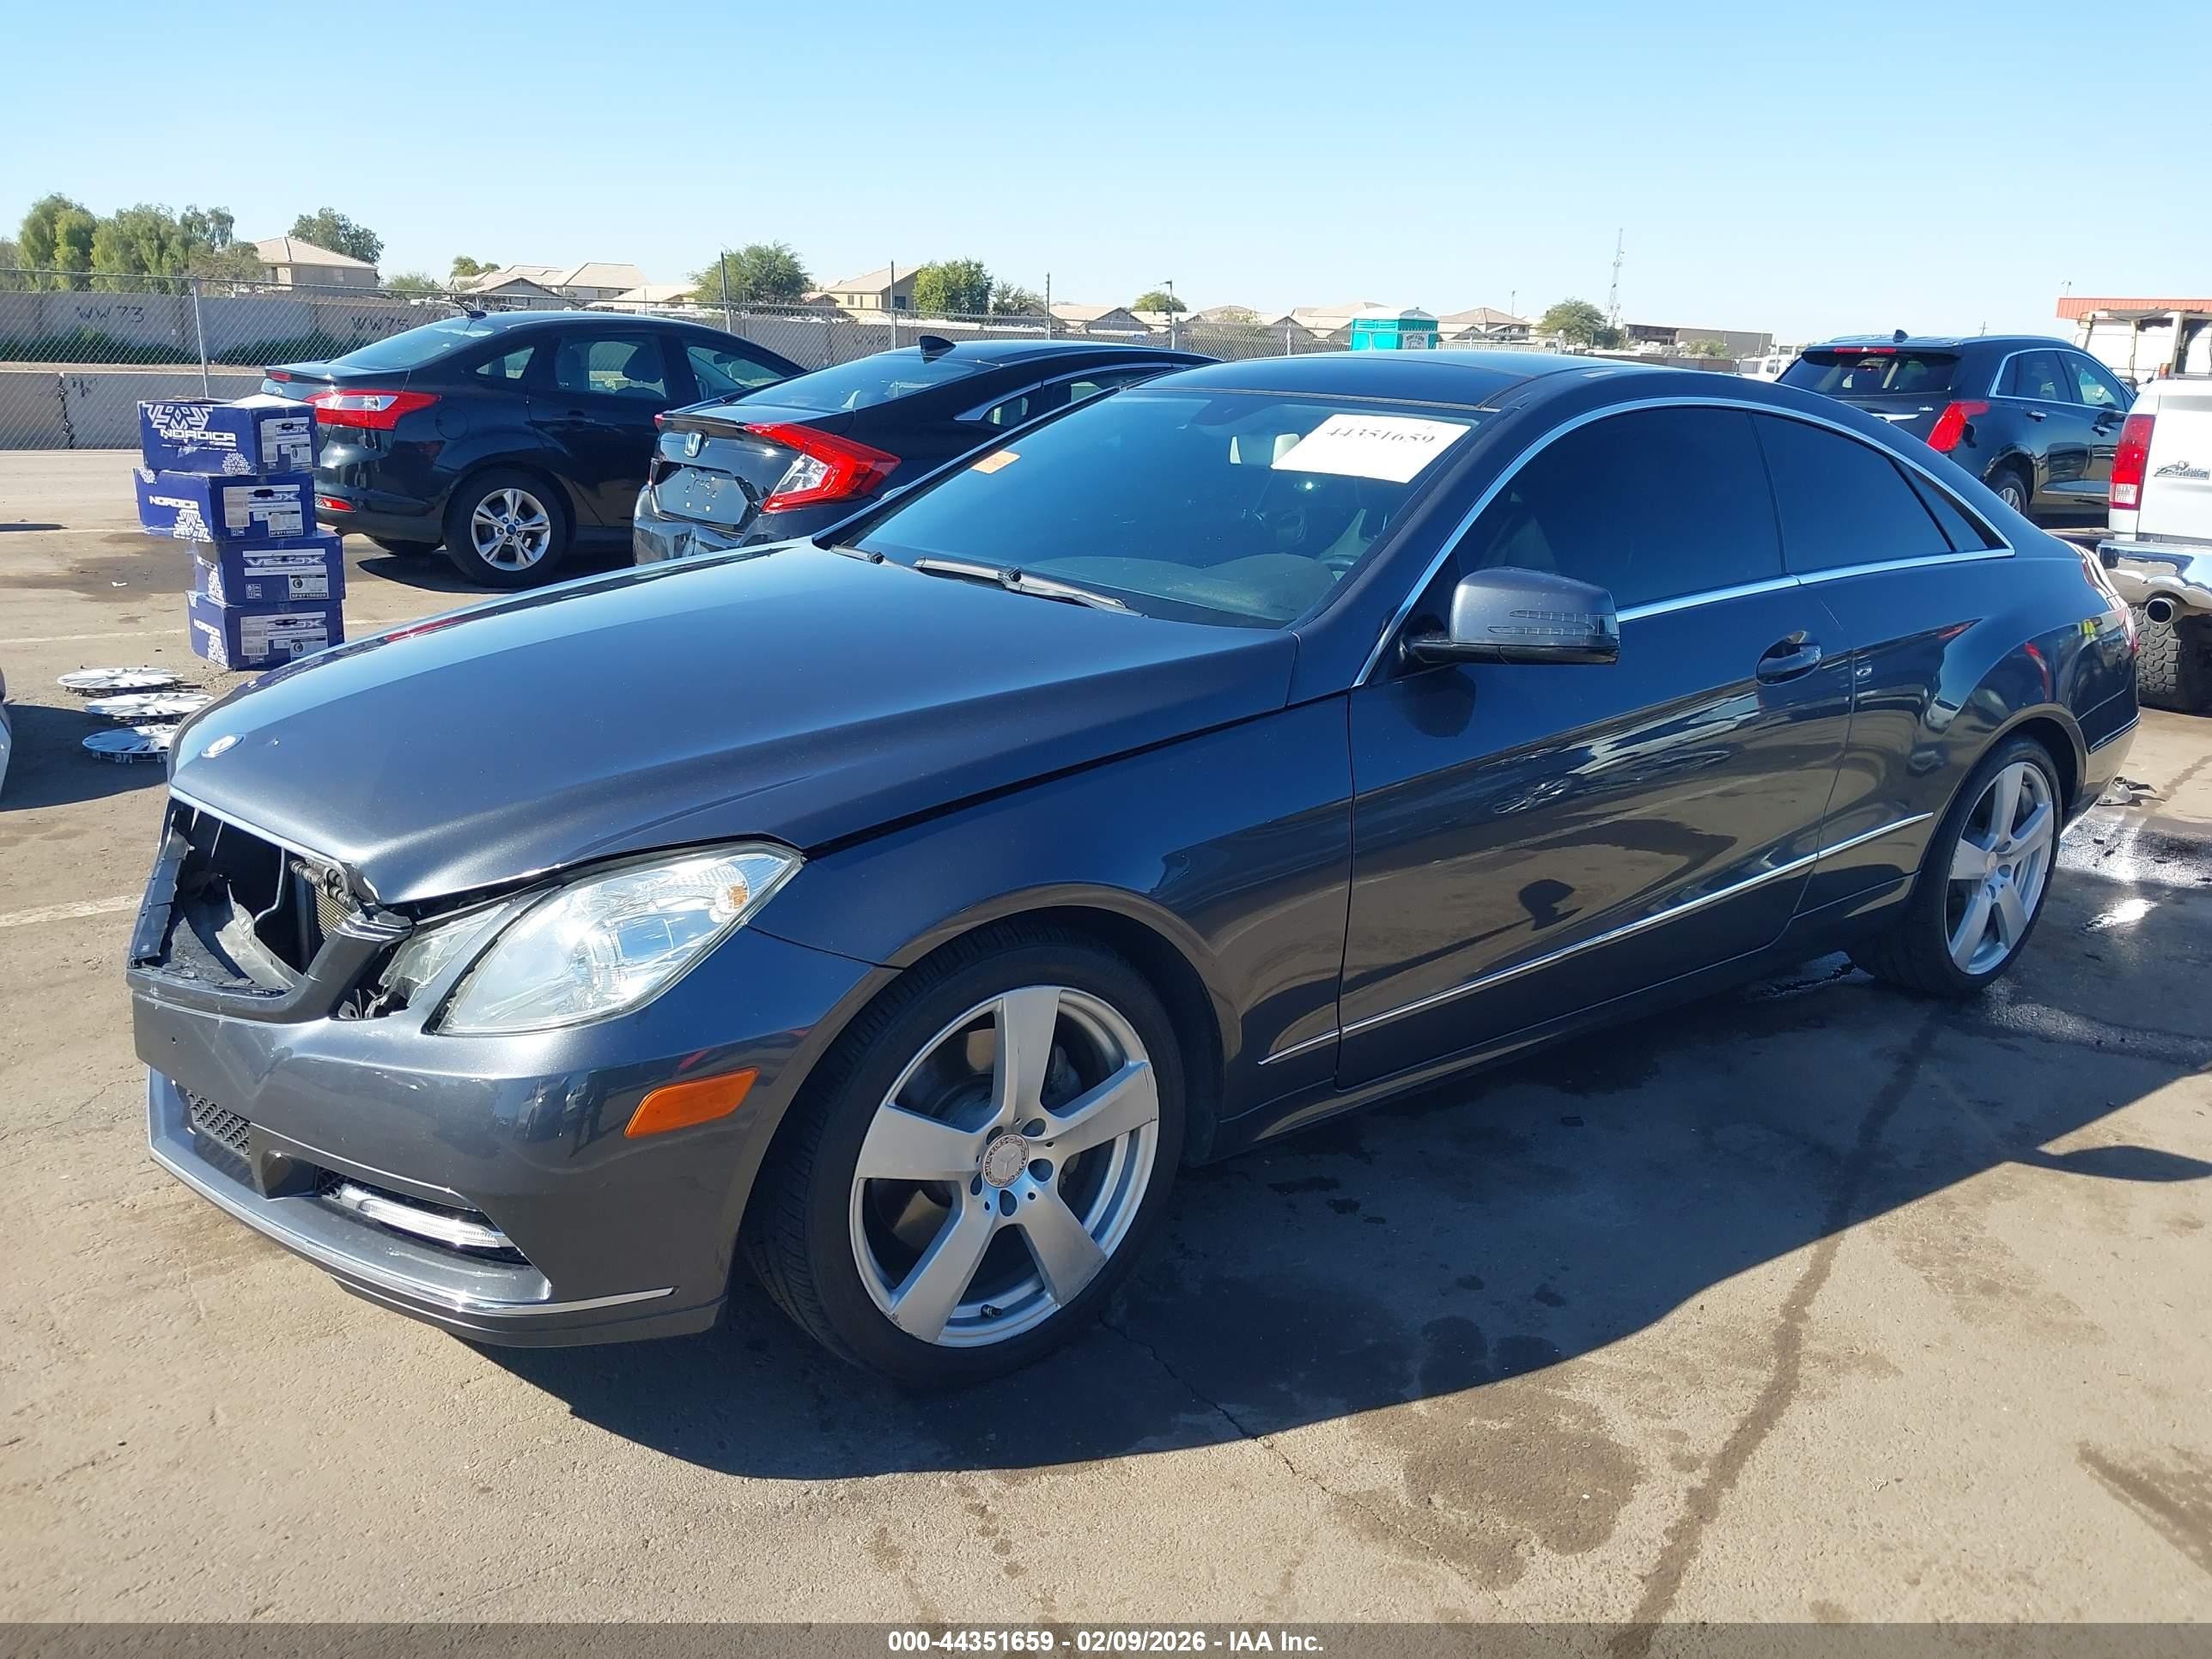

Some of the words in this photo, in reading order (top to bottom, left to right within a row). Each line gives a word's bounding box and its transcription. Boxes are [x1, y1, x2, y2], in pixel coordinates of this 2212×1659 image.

[160, 428, 237, 442] NORDICA
[1327, 427, 1436, 444] 44351659
[149, 495, 199, 510] NORDICA
[242, 556, 326, 567] VELOX
[193, 617, 221, 637] NORDICA
